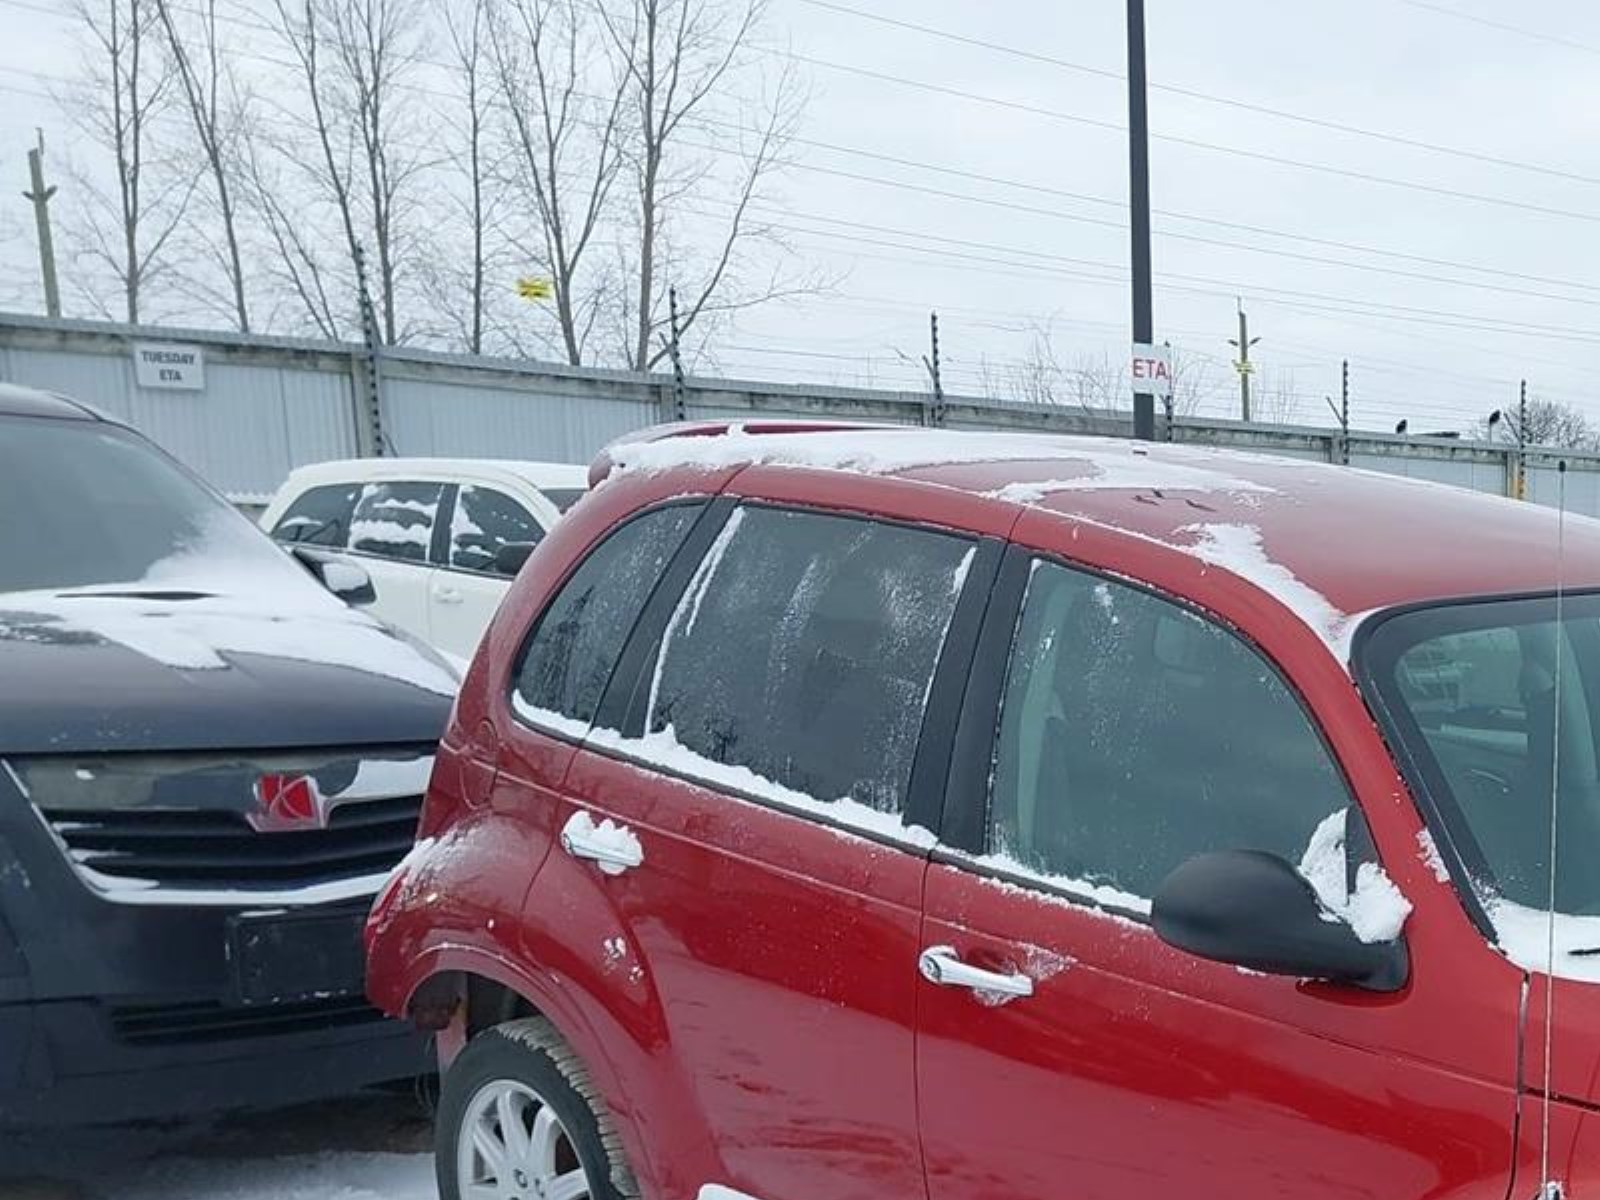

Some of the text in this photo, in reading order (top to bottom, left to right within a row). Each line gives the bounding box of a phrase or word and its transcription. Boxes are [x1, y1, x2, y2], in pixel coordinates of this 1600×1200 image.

[141, 350, 195, 365] TUESDAY
[158, 368, 183, 381] ETA
[1132, 357, 1169, 380] ETA
